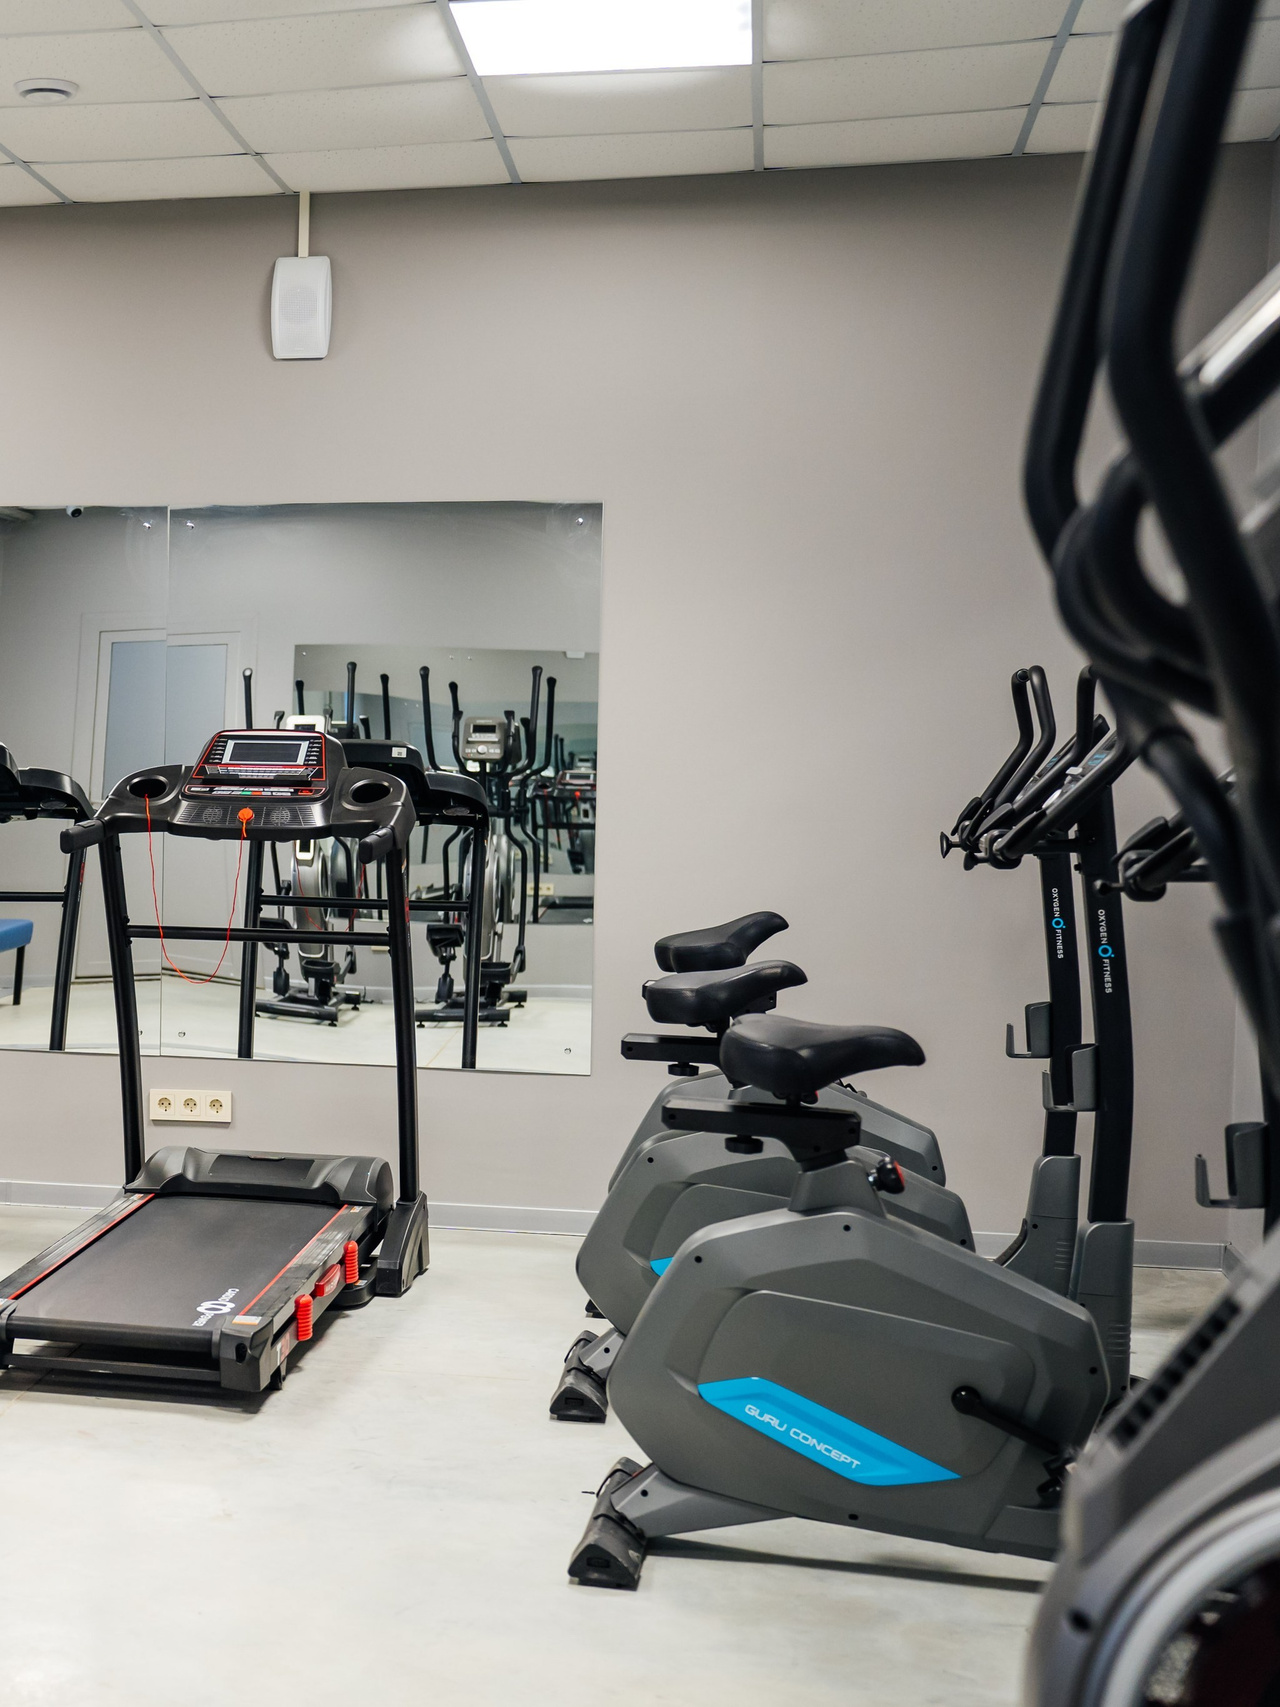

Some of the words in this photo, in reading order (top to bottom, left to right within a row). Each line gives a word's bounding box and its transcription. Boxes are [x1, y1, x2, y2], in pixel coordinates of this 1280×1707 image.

[1051, 887, 1060, 917] OXYGEN
[1055, 929, 1064, 959] FITNESS
[1097, 909, 1108, 944] OXYGEN
[1102, 959, 1113, 994] FITNESS
[745, 1404, 787, 1431] GURU
[789, 1427, 861, 1469] CONCEPT
